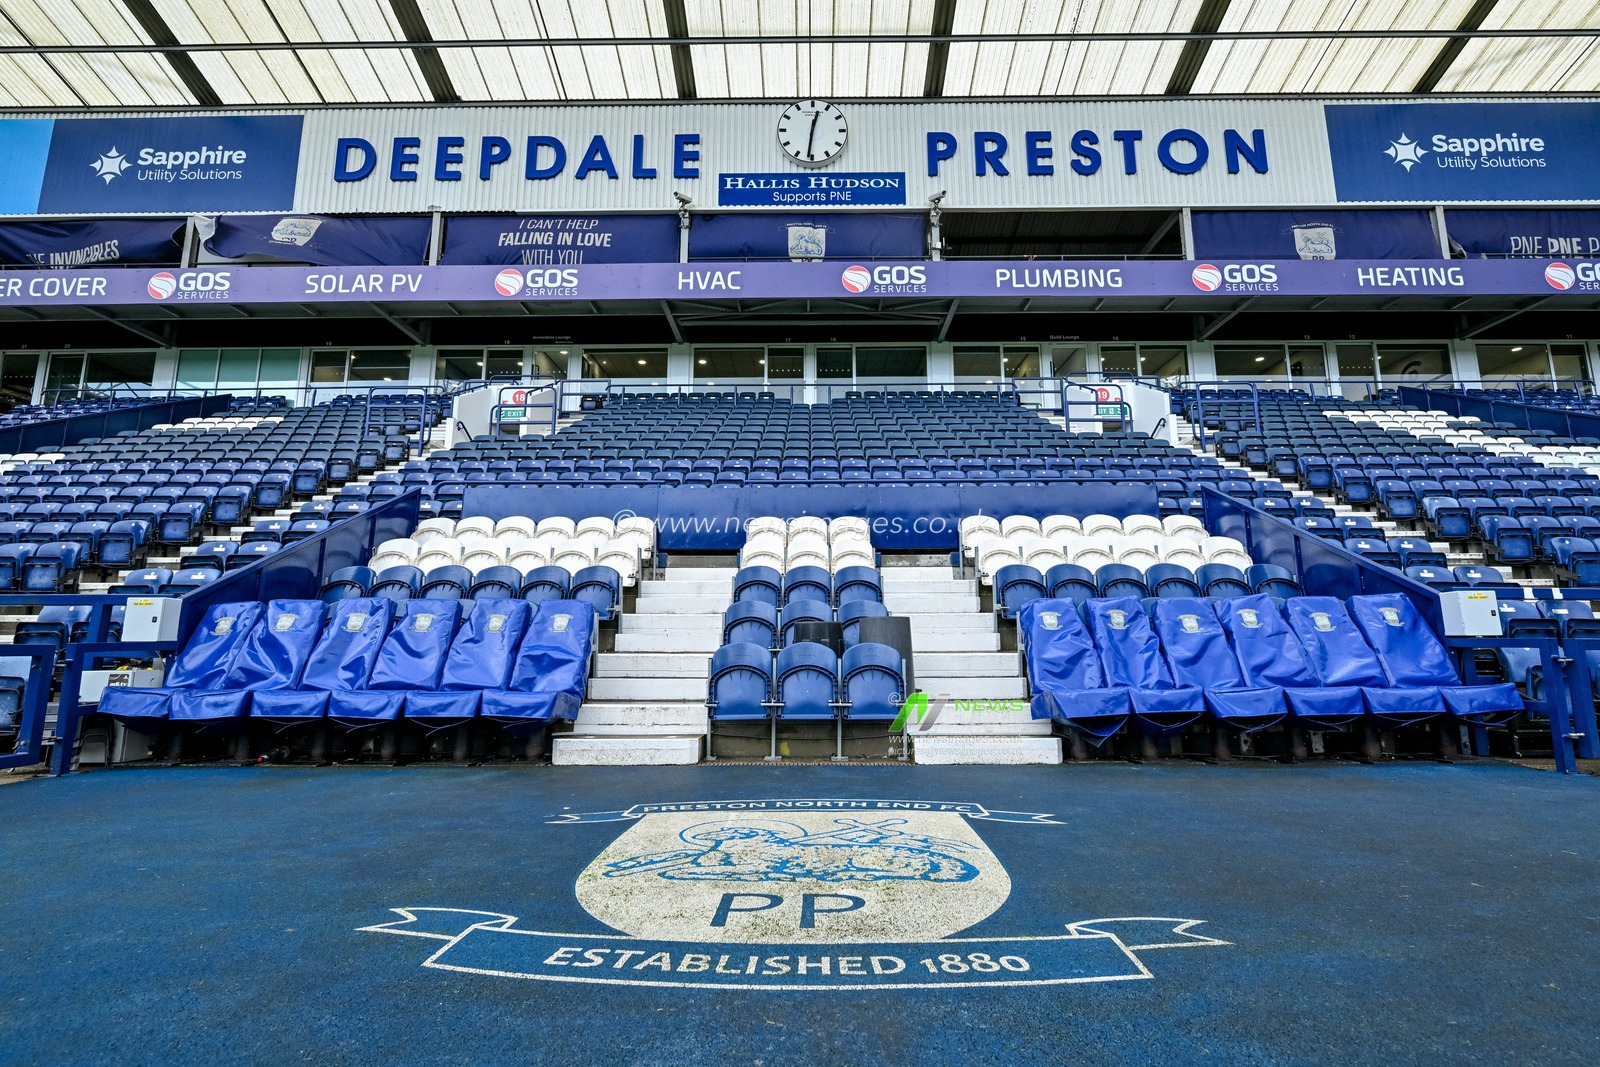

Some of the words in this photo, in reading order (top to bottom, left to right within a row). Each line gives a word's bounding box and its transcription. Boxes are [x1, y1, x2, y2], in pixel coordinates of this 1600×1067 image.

[927, 128, 1268, 176] PRESTON
[1432, 132, 1545, 156] Sapphire
[138, 145, 246, 170] Sapphire
[334, 132, 700, 183] DEEPDALE
[1437, 156, 1478, 171] Utility
[1480, 155, 1547, 169] Solutions
[137, 169, 177, 183] Utility
[179, 168, 242, 181] Solutions
[724, 177, 800, 189] HALLIS
[808, 176, 900, 189] HUDSON
[773, 191, 826, 203] Supports
[830, 191, 852, 201] PNE
[519, 219, 524, 229] I
[527, 219, 565, 230] CAN'T
[566, 219, 599, 230] HELP
[498, 231, 554, 247] FALLING
[557, 232, 573, 246] IN
[577, 232, 612, 247] LOVE
[49, 239, 120, 268] INVINCIBLES
[522, 249, 553, 265] WITH
[558, 249, 583, 265] YOU
[179, 271, 231, 292] GOS
[526, 268, 579, 288] GOS
[678, 271, 741, 291] HVAC
[873, 266, 927, 285] GOS
[995, 268, 1122, 288] PLUMBING
[1223, 264, 1278, 283] GOS
[1357, 267, 1465, 287] HEATING
[29, 277, 107, 297] COVER
[305, 274, 383, 294] SOLAR
[391, 273, 423, 292] PV
[525, 288, 578, 297] SERVICES
[873, 284, 927, 293] SERVICES
[1225, 282, 1279, 292] SERVICES
[177, 291, 229, 300] SERVICES
[515, 394, 526, 402] 18
[643, 802, 766, 812] PRESTON
[877, 802, 932, 810] END
[940, 804, 971, 812] FC
[710, 893, 866, 928] PP
[542, 947, 905, 975] ESTABLISHED
[919, 955, 1030, 974] 1880
